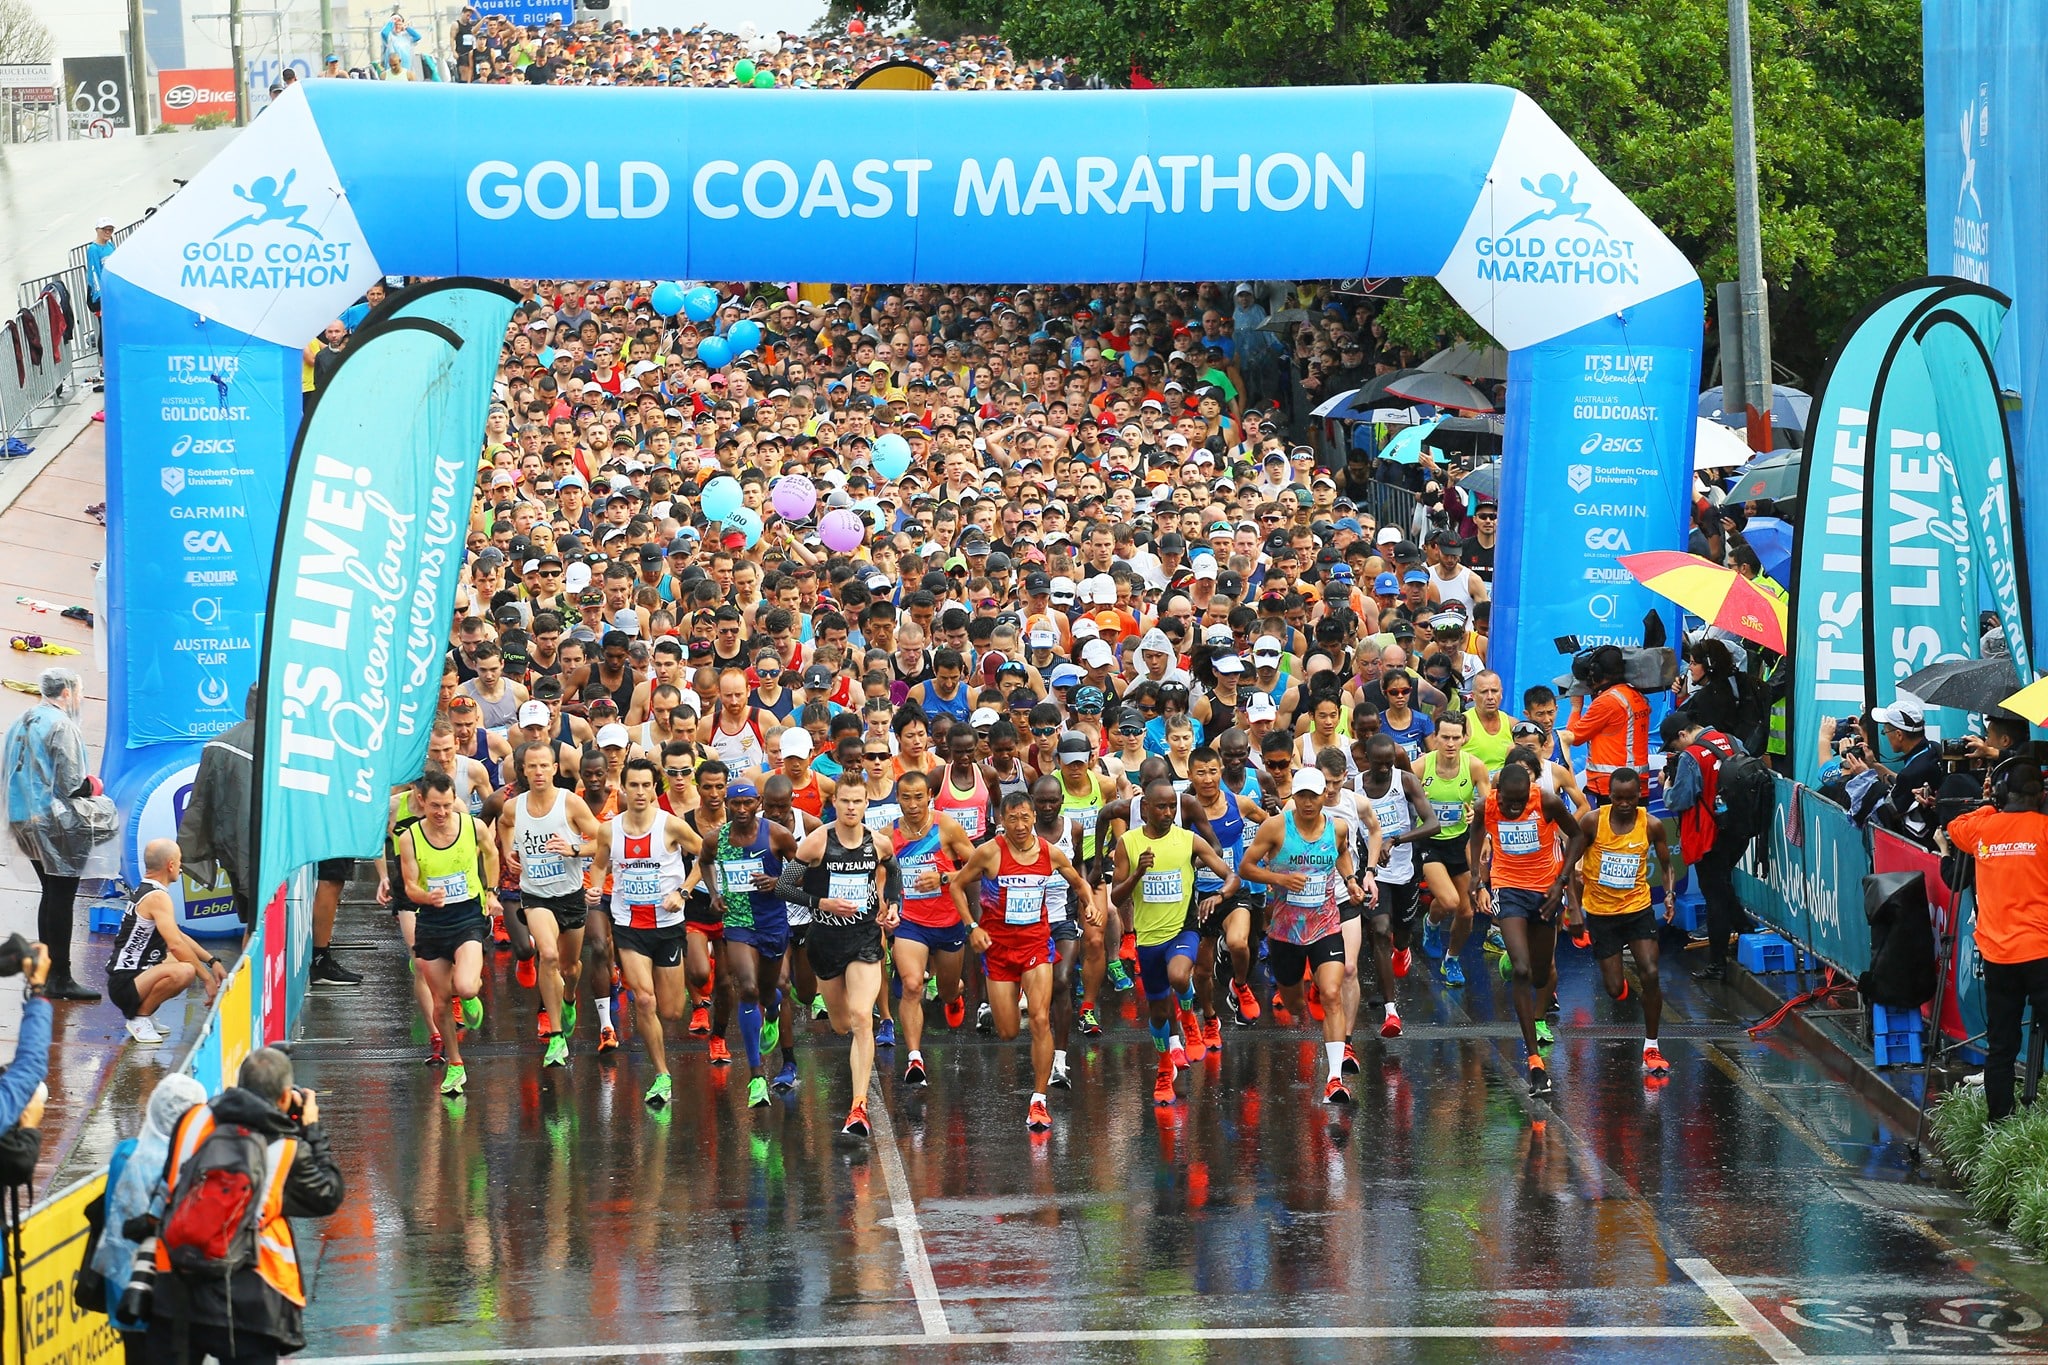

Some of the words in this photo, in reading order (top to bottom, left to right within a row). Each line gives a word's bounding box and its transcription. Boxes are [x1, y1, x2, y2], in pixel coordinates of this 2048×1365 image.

[473, 0, 521, 10] Aquatic
[528, 0, 569, 8] Centre
[523, 13, 553, 24] RIGH
[72, 80, 120, 115] 68
[168, 89, 195, 104] 99
[466, 160, 670, 220] GOLD
[692, 159, 933, 219] COAST
[953, 151, 1365, 217] MARATHON
[1966, 220, 1989, 256] COAST
[182, 242, 254, 264] GOLD
[264, 243, 352, 264] COAST
[1475, 236, 1545, 259] GOLD
[1555, 237, 1635, 260] COAST
[181, 264, 349, 288] MARATHON
[1476, 259, 1639, 285] MARATHON
[168, 356, 195, 371] IT'S
[200, 356, 239, 372] LIVE!
[1585, 355, 1612, 370] IT'S
[1615, 355, 1653, 371] LIVE!
[1594, 368, 1649, 384] Queensland
[1595, 467, 1634, 475] Southern
[188, 478, 233, 487] University
[1595, 476, 1638, 485] University
[170, 506, 246, 519] GARMIN
[726, 511, 747, 526] 3:00
[1574, 503, 1648, 518] GARMIN
[1890, 428, 1942, 606] LIVE!
[183, 530, 232, 553] GCA
[1584, 527, 1631, 551] GCA
[289, 454, 373, 651] LIVE!
[184, 571, 238, 583] ENDURA
[1584, 567, 1634, 580] ENDURA
[329, 489, 416, 758] Queensland
[1740, 615, 1764, 633] SUNS
[173, 638, 251, 651] AUSTRALIA
[1570, 634, 1640, 647] USTRALIA
[197, 653, 228, 665] FAIR
[188, 720, 240, 736] gaden
[278, 662, 343, 796] IT'S
[348, 767, 375, 803] in
[525, 844, 547, 855] cre
[1989, 843, 2013, 851] EVENT
[2013, 842, 2037, 850] CREW
[826, 862, 844, 871] NEW
[845, 861, 876, 871] ZEALAND
[899, 853, 936, 866] MONGOLIA
[1289, 855, 1334, 865] MONGOLIA
[528, 862, 560, 878] SAINT
[727, 871, 756, 884] LAGA
[1601, 862, 1633, 878] CHEBOR
[623, 881, 655, 894] HOBBS
[1144, 881, 1178, 895] BIRIR
[192, 900, 234, 917] Label
[22, 1280, 64, 1351] KEEP
